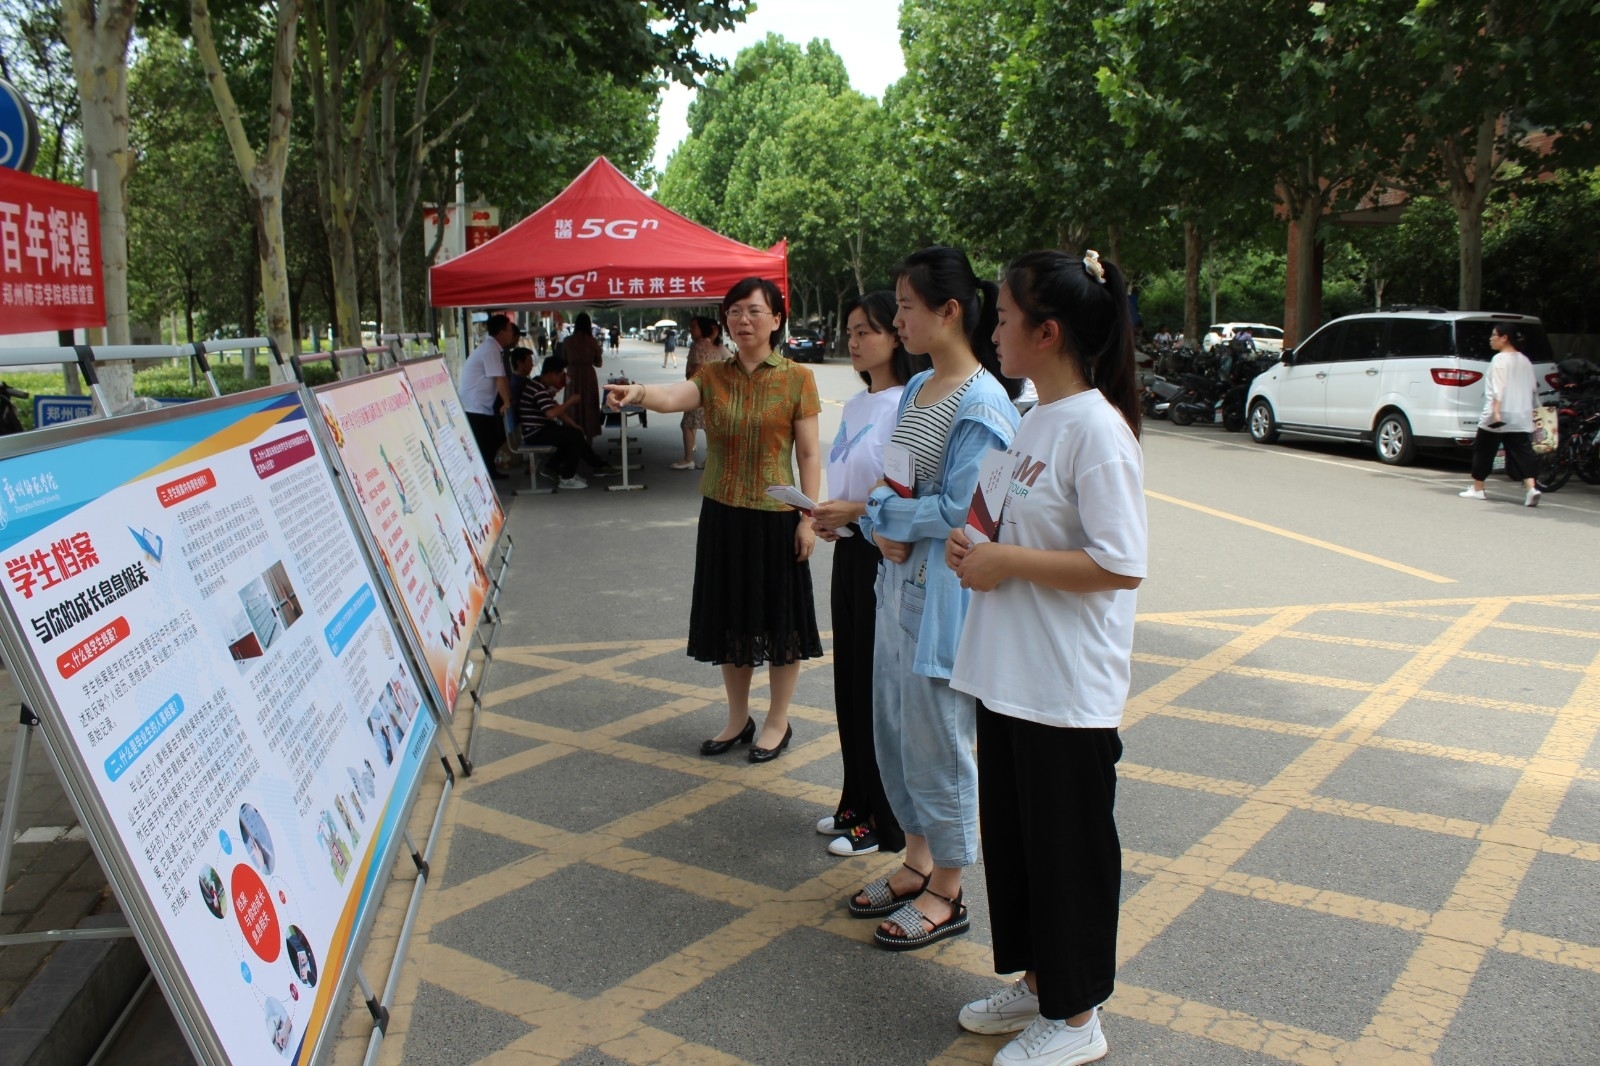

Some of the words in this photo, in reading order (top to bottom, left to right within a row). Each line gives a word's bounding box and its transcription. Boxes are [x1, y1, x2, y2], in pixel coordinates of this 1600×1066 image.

[0, 201, 92, 277] 百年辉煌
[608, 276, 706, 294] 让未来生长
[47, 406, 93, 421] 郑州师
[3, 529, 101, 602] 学生档案
[29, 560, 150, 645] 与你的成长息息相关
[60, 625, 119, 674] 一、什么是学生档案?
[235, 889, 248, 915] 档案
[243, 886, 266, 931] 与你的成长
[250, 907, 270, 947] 息息相关
